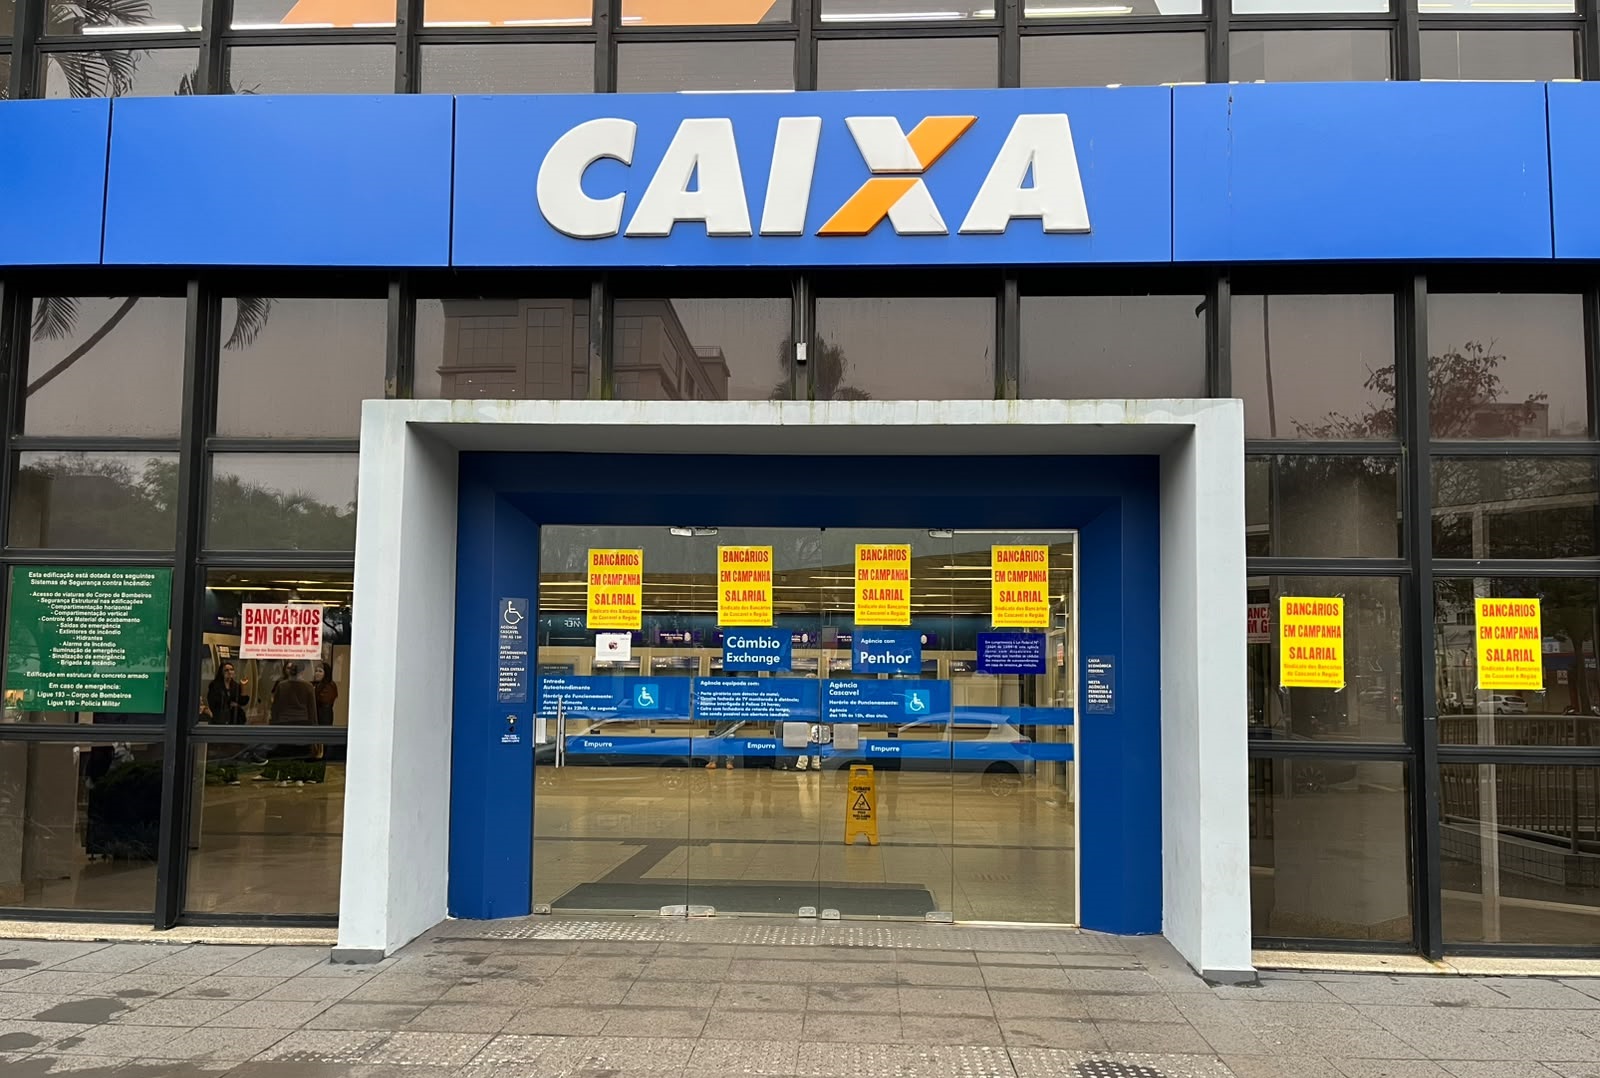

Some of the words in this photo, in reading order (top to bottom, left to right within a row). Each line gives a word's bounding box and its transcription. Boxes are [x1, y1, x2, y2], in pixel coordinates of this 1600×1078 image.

[536, 113, 1092, 238] CAIXA
[593, 552, 638, 565] BANCÁRIOS
[723, 549, 768, 562] BANCÁRIOS
[861, 547, 906, 560] BANCÁRIOS
[997, 549, 1044, 562] BANCÁRIOS
[591, 574, 601, 585] EM
[603, 574, 640, 585] CAMPANHA
[721, 571, 731, 582] EM
[733, 571, 770, 582] CAMPANHA
[858, 569, 868, 580] EM
[870, 569, 908, 580] CAMPANHA
[995, 571, 1005, 582] EM
[1008, 571, 1046, 582] CAMPANHA
[595, 594, 636, 605] SALARIAL
[725, 590, 766, 601] SALARIAL
[862, 589, 904, 600] SALARIAL
[1000, 591, 1042, 602] SALARIAL
[245, 605, 320, 625] BANCÁRIOS
[1286, 601, 1339, 616] BANCÁRIOS
[1482, 602, 1535, 617] BANCÁRIOS
[245, 626, 267, 645] EM
[273, 626, 319, 645] GREVE
[1284, 625, 1296, 637] EM
[1298, 625, 1341, 638] CAMPANHA
[1480, 626, 1492, 639] EM
[1495, 626, 1538, 639] CAMPANHA
[726, 636, 780, 648] Câmbio
[726, 652, 780, 665] Exchange
[860, 651, 912, 664] Penhor
[1289, 646, 1336, 660] SALARIAL
[1486, 649, 1534, 662] SALARIAL
